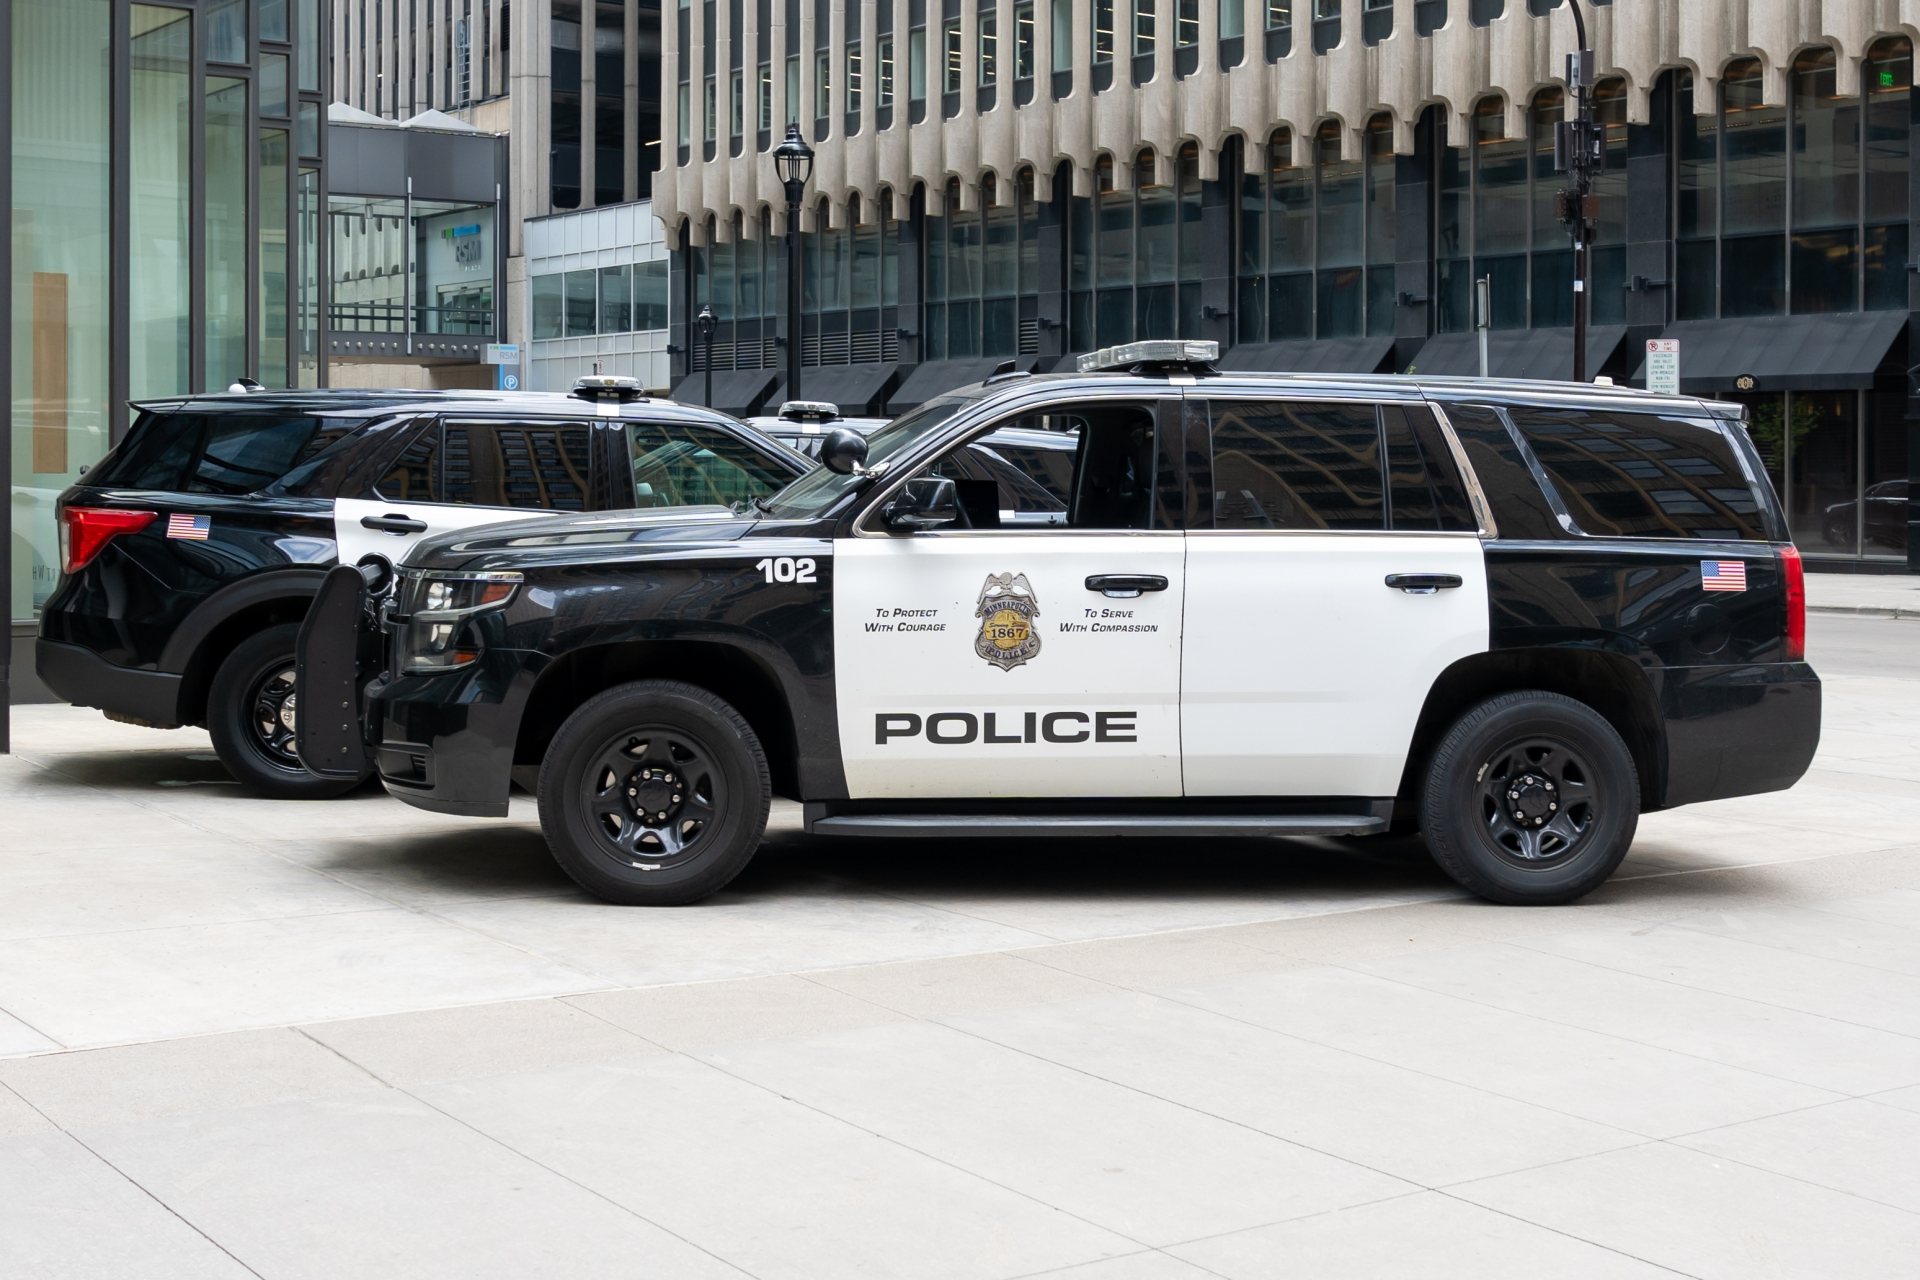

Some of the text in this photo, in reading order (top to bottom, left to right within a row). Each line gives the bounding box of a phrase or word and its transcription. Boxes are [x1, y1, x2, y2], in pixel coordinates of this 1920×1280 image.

[456, 241, 481, 262] RSM
[500, 351, 518, 360] RSM
[755, 557, 817, 583] 102
[984, 601, 1032, 616] MINNEAPOLIS
[991, 628, 1025, 639] 1867
[988, 647, 1027, 660] POLICE
[875, 711, 1138, 745] POLICE
